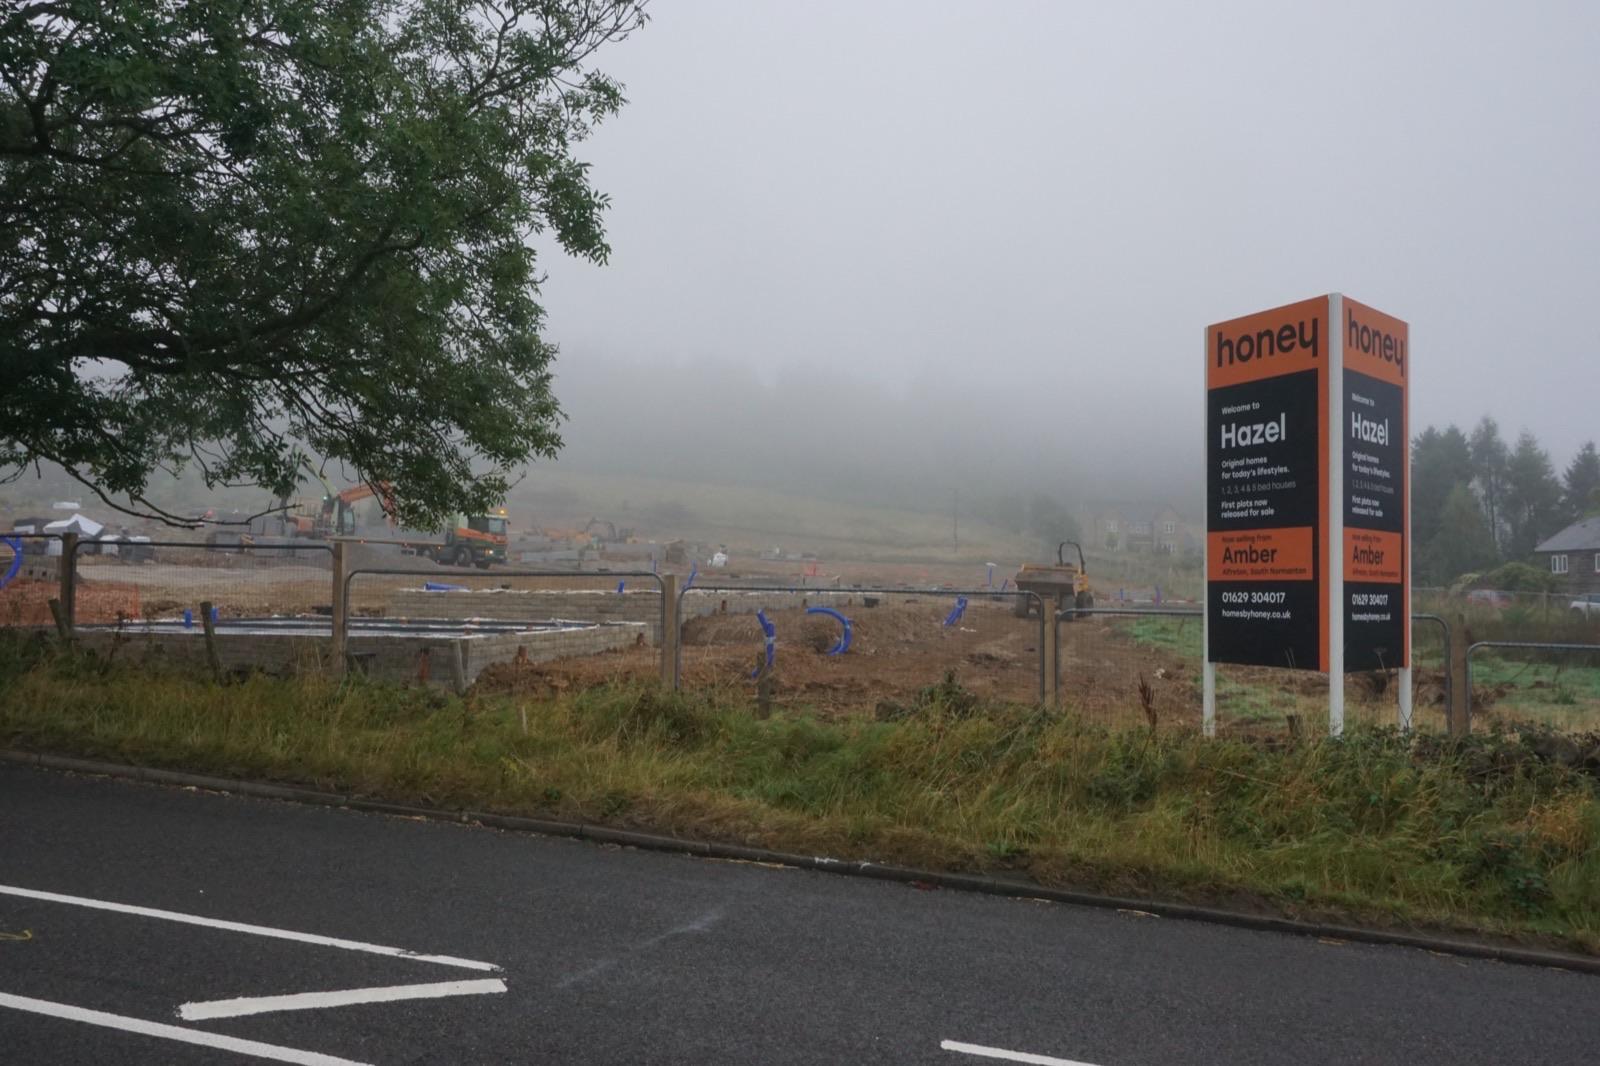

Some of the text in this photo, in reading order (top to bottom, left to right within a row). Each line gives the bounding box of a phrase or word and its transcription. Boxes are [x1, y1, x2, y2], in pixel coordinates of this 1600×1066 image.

[1217, 318, 1318, 368] honey
[1348, 307, 1404, 377] honey
[1221, 401, 1260, 415] Welcome to
[1221, 412, 1286, 449] Hazel
[1352, 411, 1389, 446] Hazel
[1221, 456, 1268, 469] Original homes
[1221, 471, 1231, 479] for
[1232, 468, 1256, 479] today's
[1221, 499, 1268, 510] First plots now
[1221, 507, 1275, 518] released for sale
[1222, 545, 1277, 564] Amber
[1353, 544, 1384, 564] Amber
[1222, 592, 1286, 603] 01629 304017
[1222, 609, 1291, 620] homesbyhoney.co.uk
